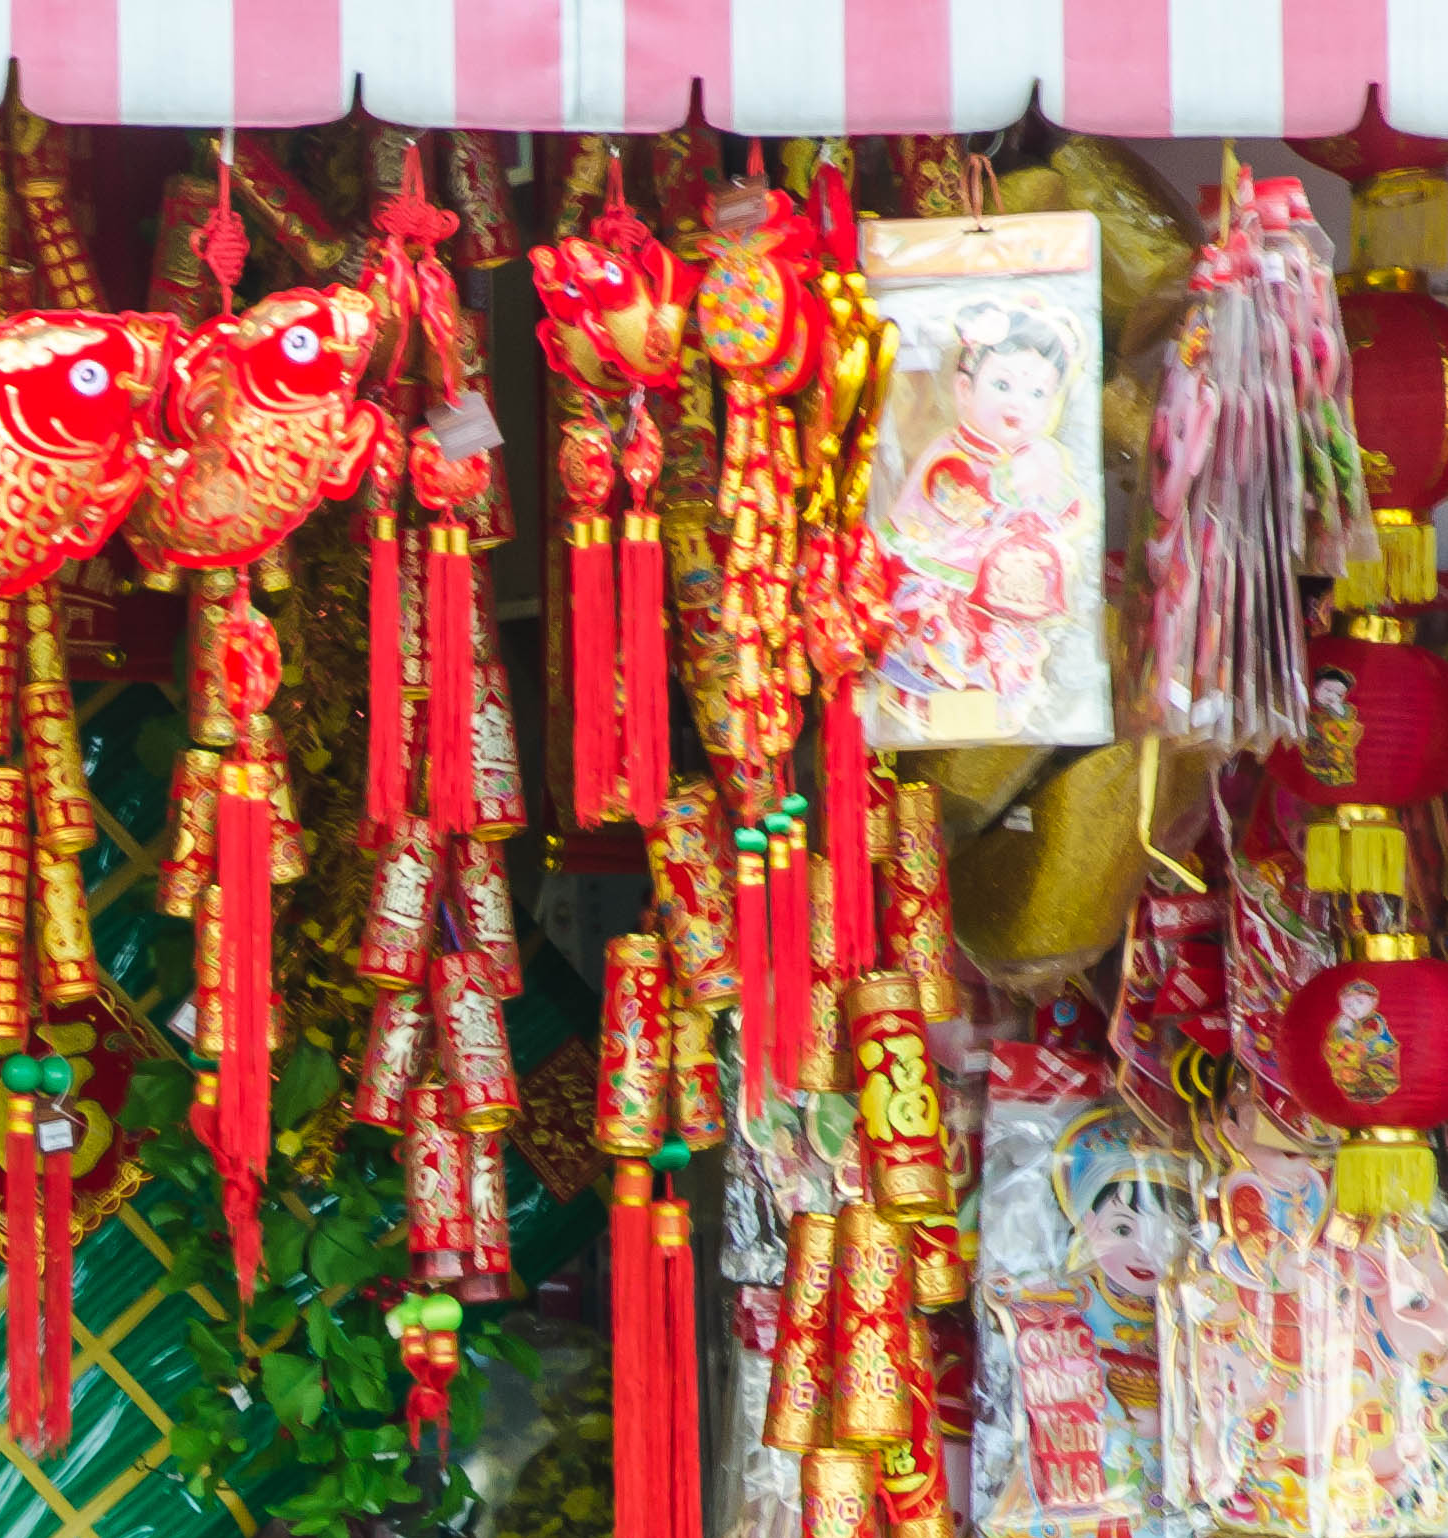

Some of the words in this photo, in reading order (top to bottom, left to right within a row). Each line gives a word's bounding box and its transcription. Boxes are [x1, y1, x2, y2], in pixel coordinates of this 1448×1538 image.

[1019, 1317, 1094, 1368] Chúc
[1022, 1363, 1105, 1412] Mừng
[1036, 1409, 1105, 1454] Năm
